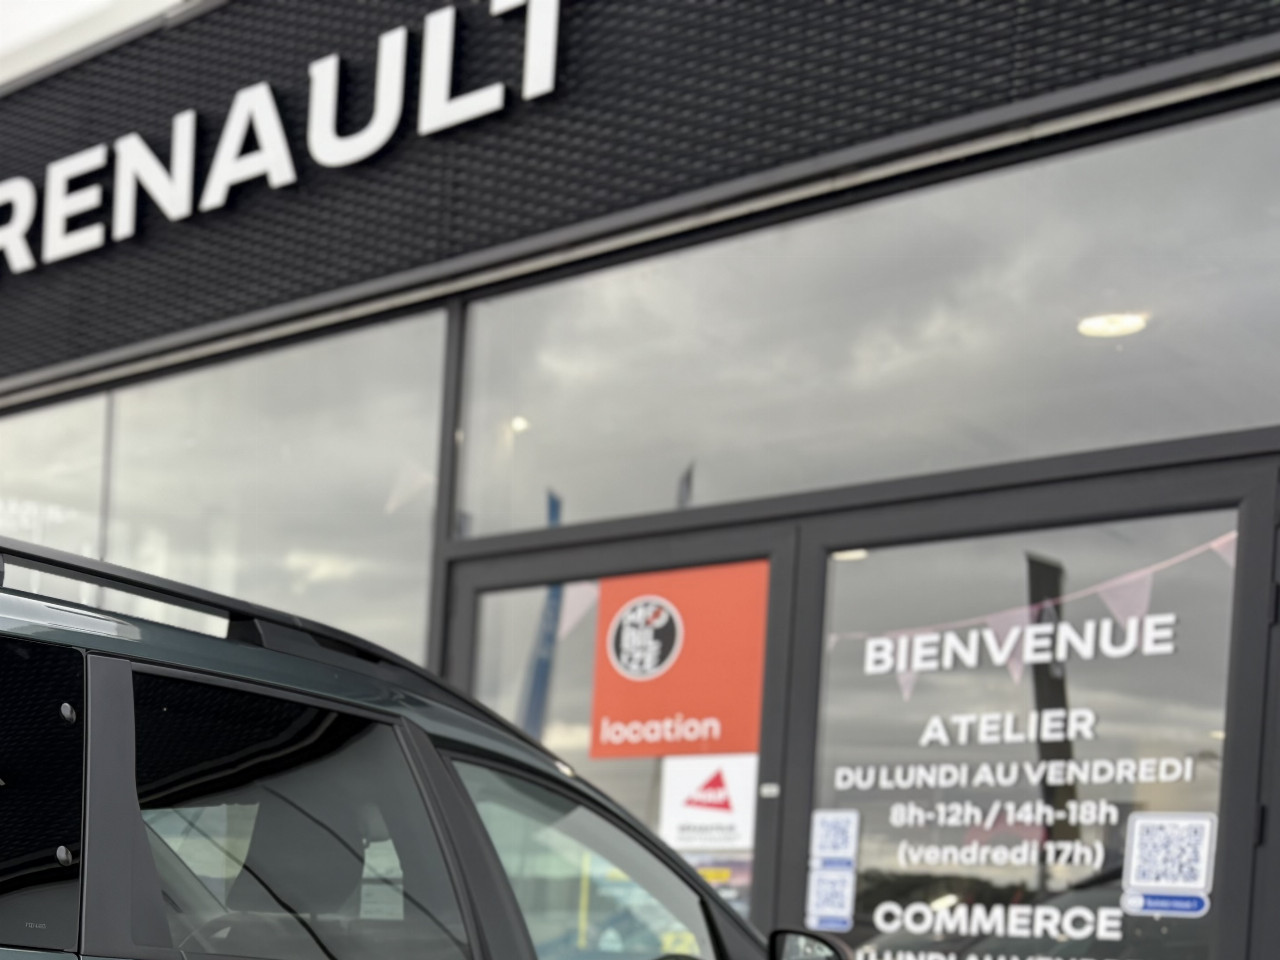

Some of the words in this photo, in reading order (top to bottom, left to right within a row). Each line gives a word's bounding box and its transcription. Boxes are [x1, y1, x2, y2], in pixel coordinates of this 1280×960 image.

[864, 613, 1177, 675] BIENVENUE
[599, 712, 721, 744] location
[920, 708, 1096, 747] ATELIER
[834, 766, 876, 790] DU
[878, 763, 968, 789] LUNDI
[972, 761, 1018, 787] AU
[1023, 757, 1194, 785] VENDREDI
[897, 840, 1037, 868] (vendredi
[1043, 839, 1105, 870] 17h)
[873, 901, 1123, 941] COMMERCE
